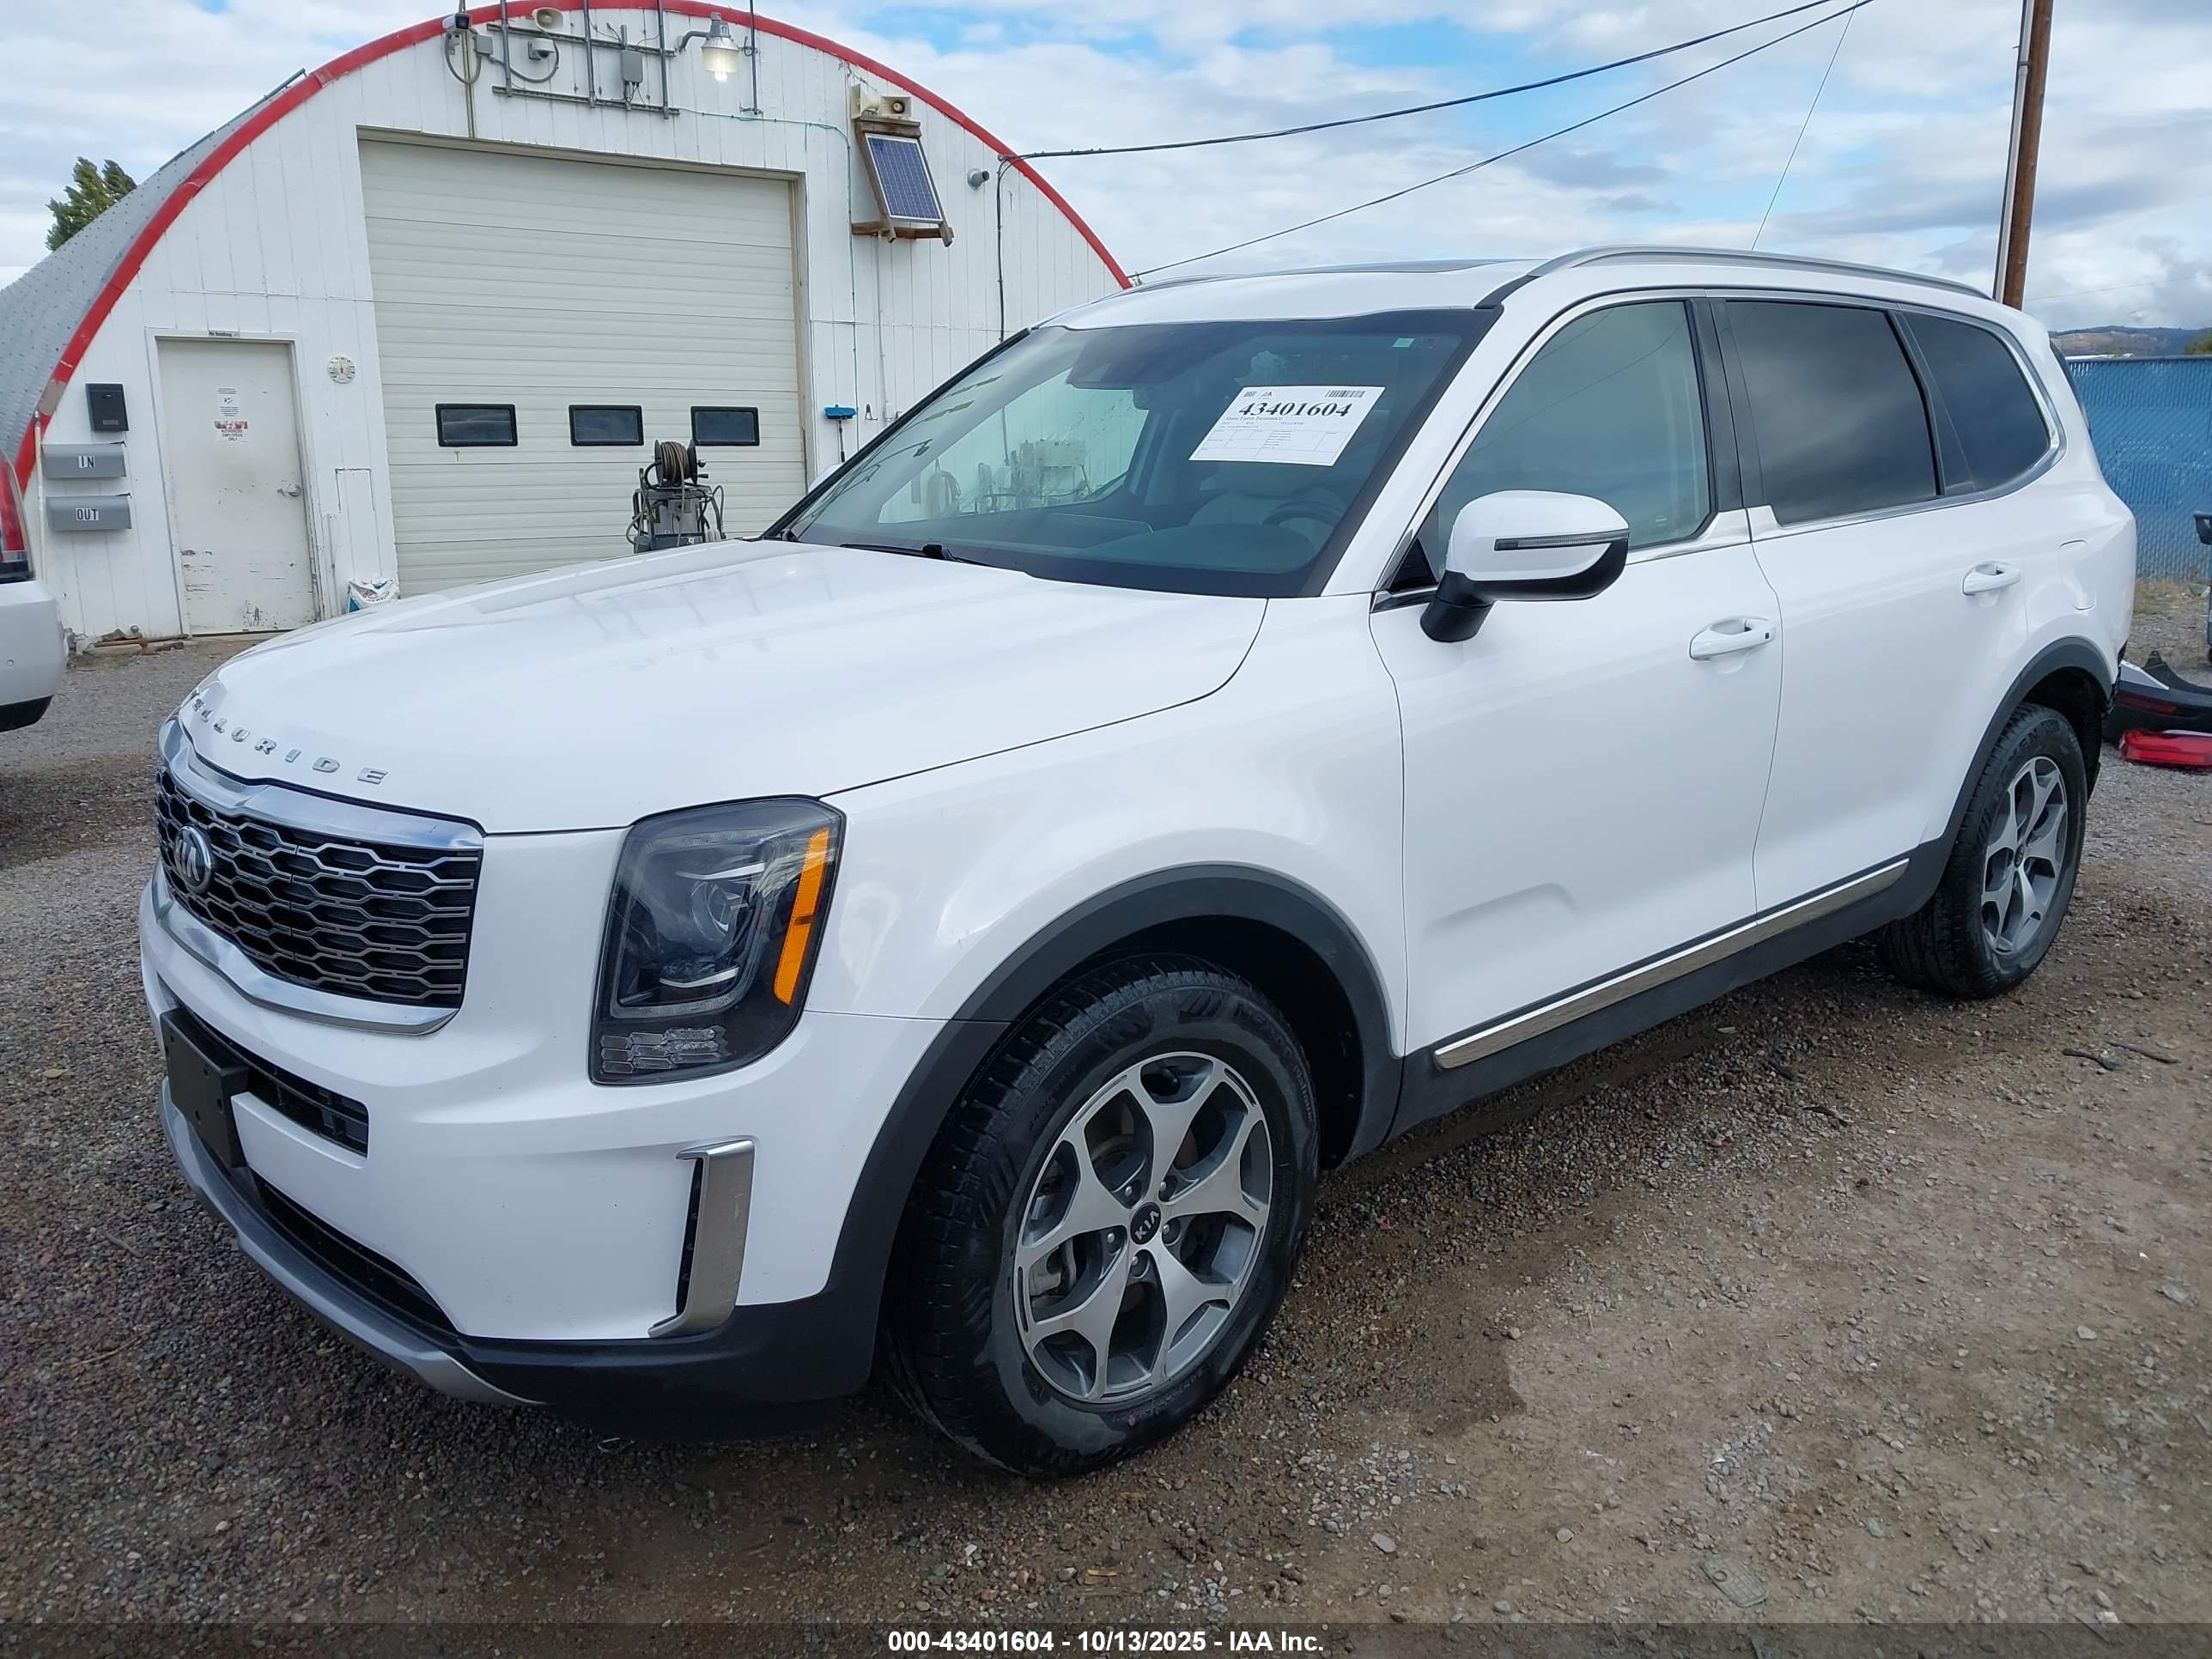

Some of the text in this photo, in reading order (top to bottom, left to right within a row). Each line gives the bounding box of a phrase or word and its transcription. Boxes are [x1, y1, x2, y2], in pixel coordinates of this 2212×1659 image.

[1238, 402, 1354, 417] 43401604
[82, 455, 94, 468] IN
[76, 508, 98, 520] OUT
[1133, 1210, 1160, 1241] KIA
